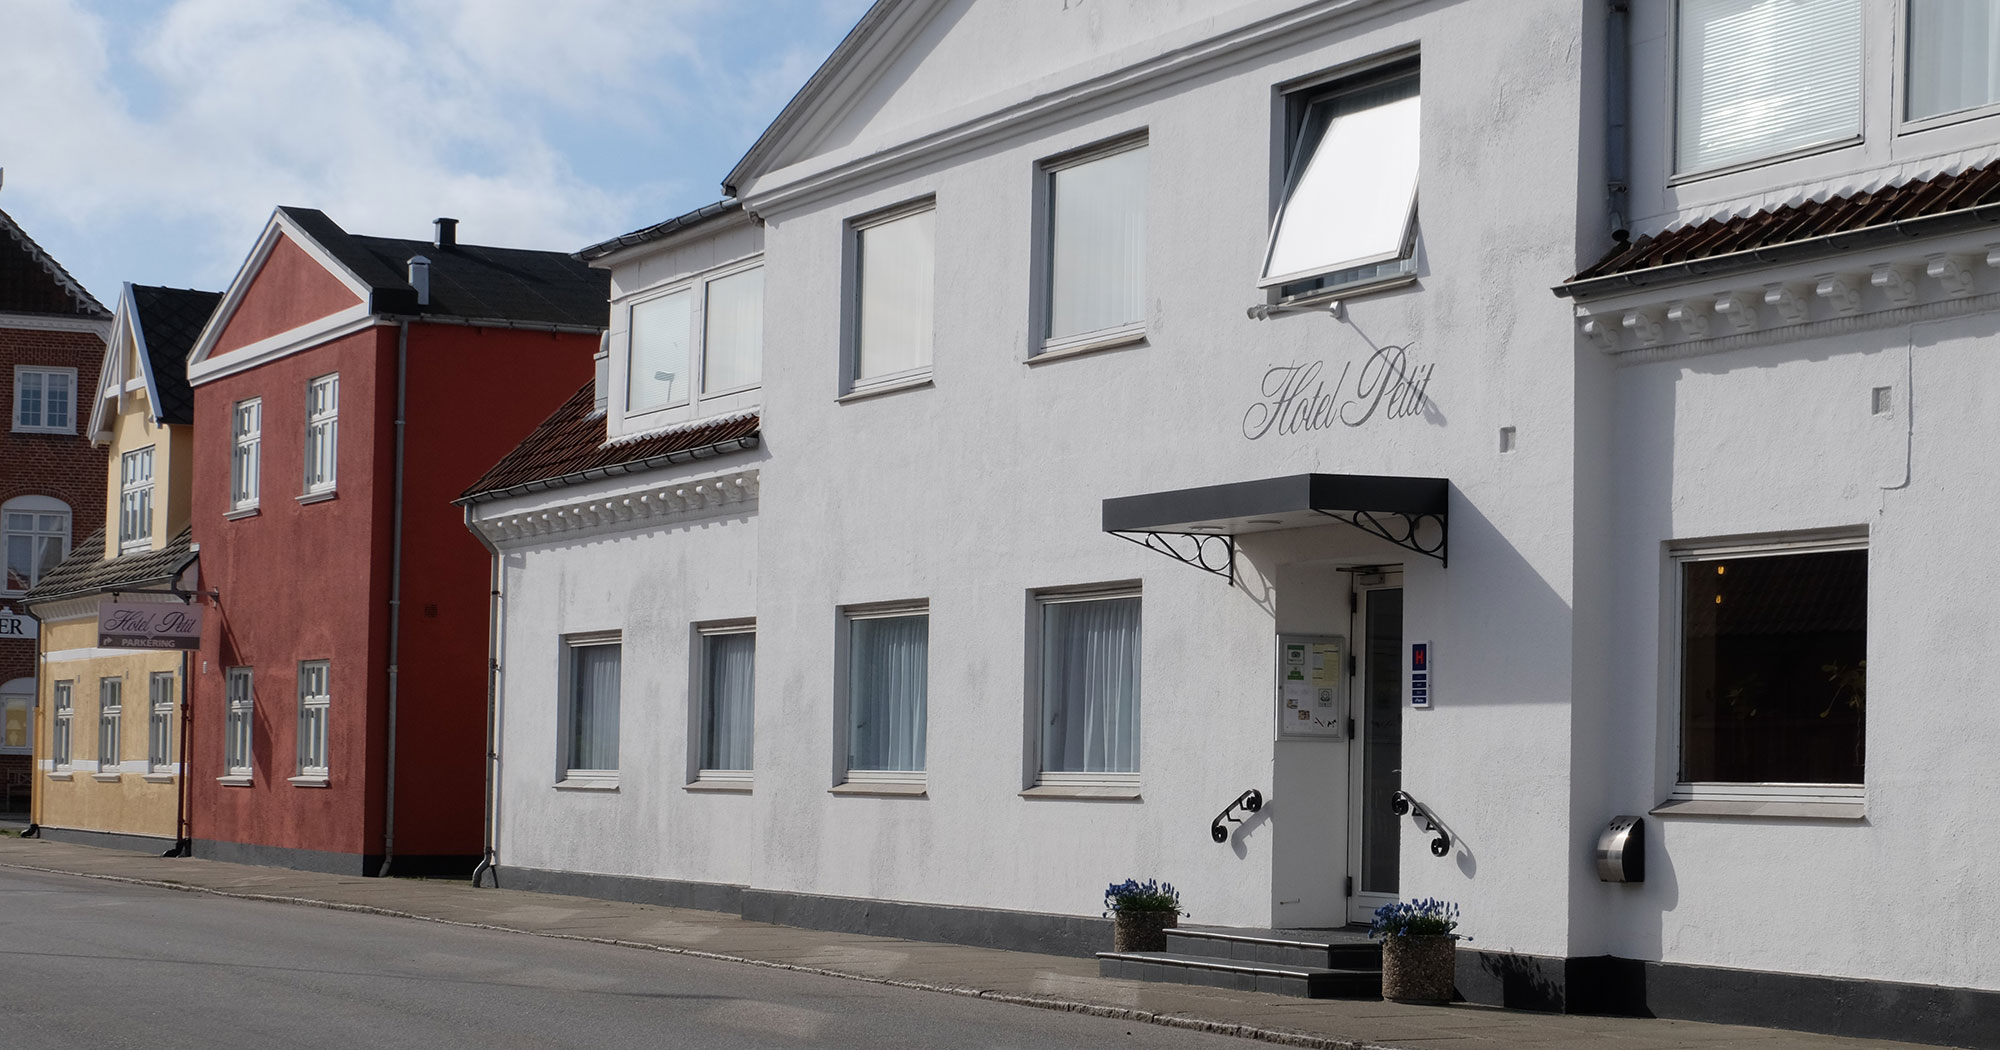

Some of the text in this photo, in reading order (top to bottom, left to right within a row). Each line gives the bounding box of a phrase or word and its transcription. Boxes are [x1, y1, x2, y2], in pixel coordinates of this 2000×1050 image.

[1242, 341, 1435, 440] Hotel Petit
[104, 609, 196, 633] Hotel Petit
[121, 638, 175, 648] PARKERING
[1415, 649, 1424, 664] H
